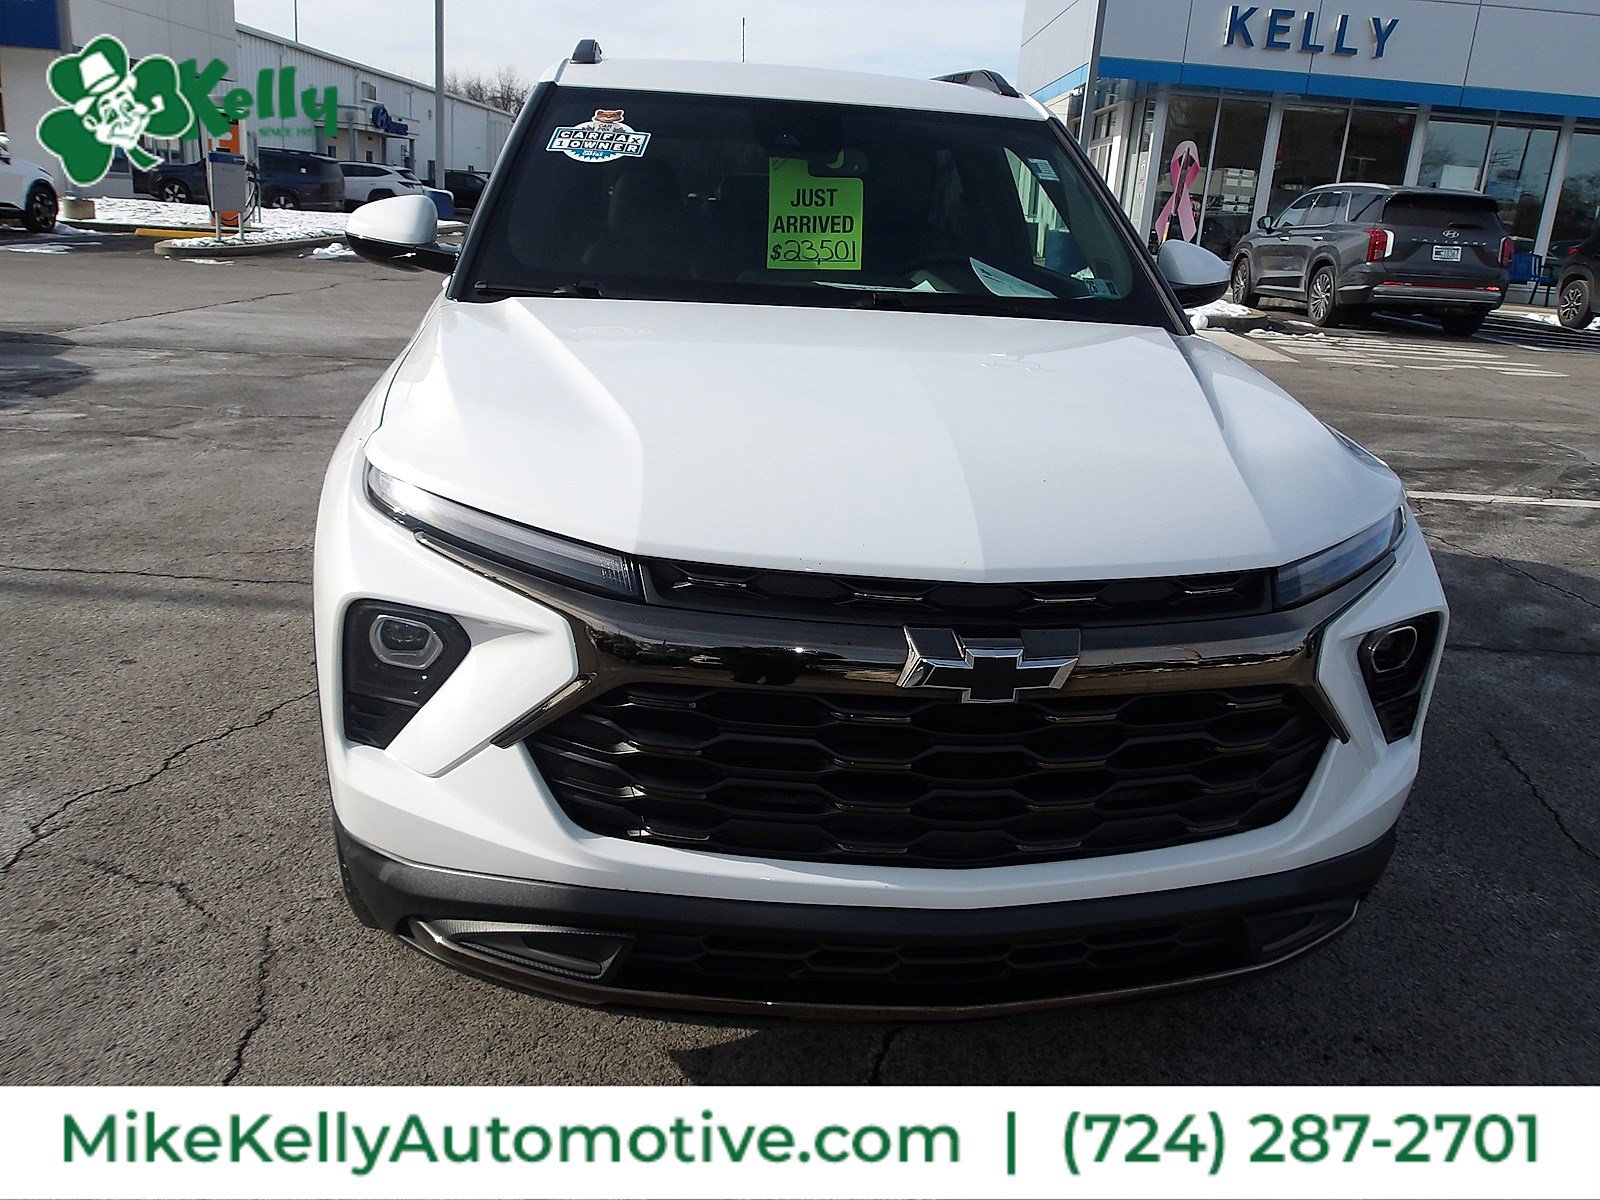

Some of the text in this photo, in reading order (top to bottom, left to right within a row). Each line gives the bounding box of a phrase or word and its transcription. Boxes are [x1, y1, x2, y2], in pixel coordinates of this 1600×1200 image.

[1223, 5, 1400, 58] KELLY
[559, 130, 642, 144] CARFAX
[569, 141, 639, 154] OWNER
[790, 188, 838, 208] JUST
[772, 215, 854, 234] ARRIVED
[770, 240, 856, 266] $23,501
